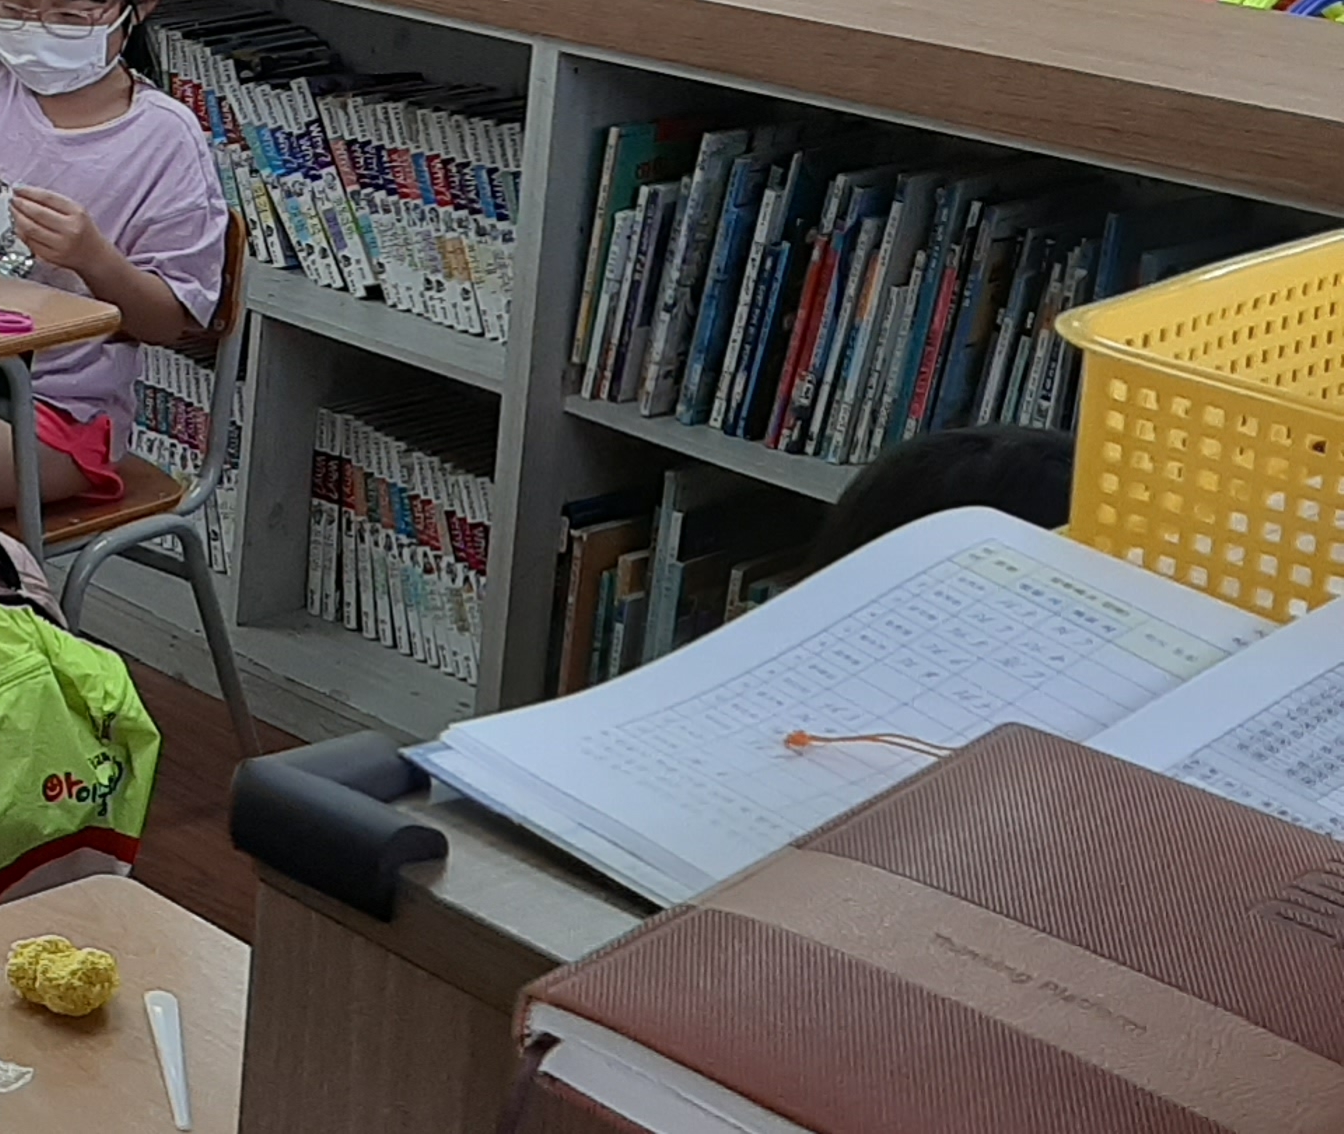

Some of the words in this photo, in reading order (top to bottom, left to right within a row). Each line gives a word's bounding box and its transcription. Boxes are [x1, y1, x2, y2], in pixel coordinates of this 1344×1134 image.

[309, 123, 331, 162] Why?
[313, 456, 327, 495] Why?
[327, 461, 340, 500] Why?
